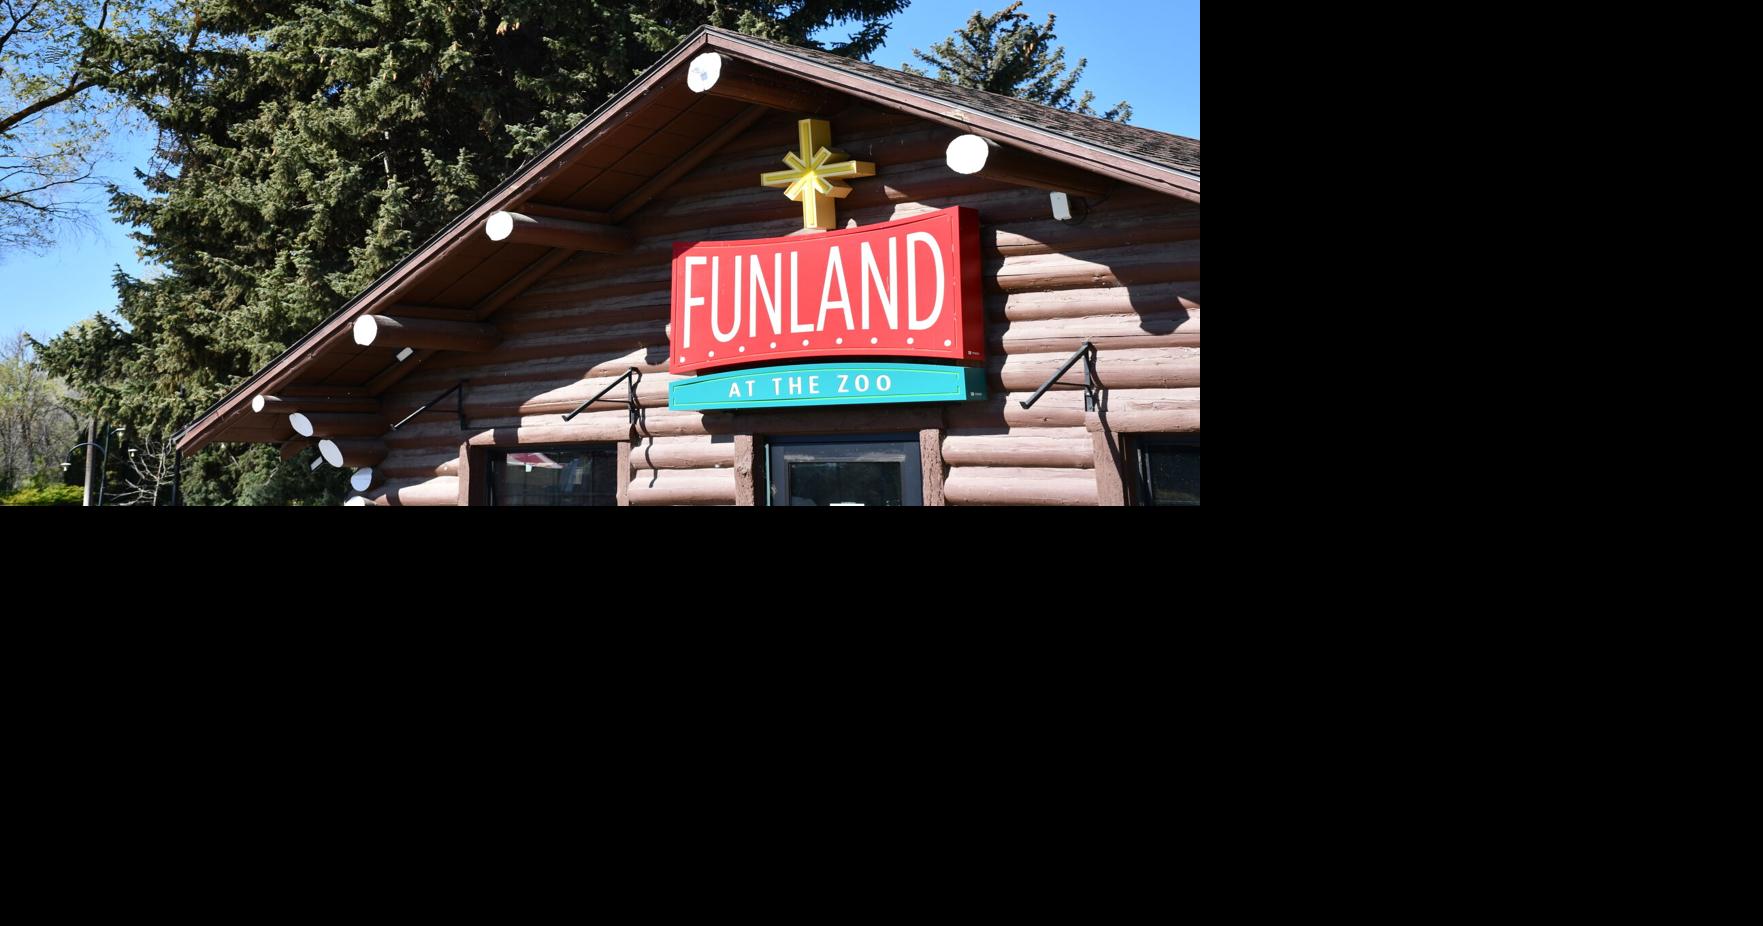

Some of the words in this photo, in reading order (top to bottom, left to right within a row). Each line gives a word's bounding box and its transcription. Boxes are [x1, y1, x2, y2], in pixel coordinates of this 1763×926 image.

[683, 231, 945, 349] FUNLAND
[728, 380, 756, 398] AT
[772, 375, 819, 396] THE
[837, 374, 892, 393] ZOO
